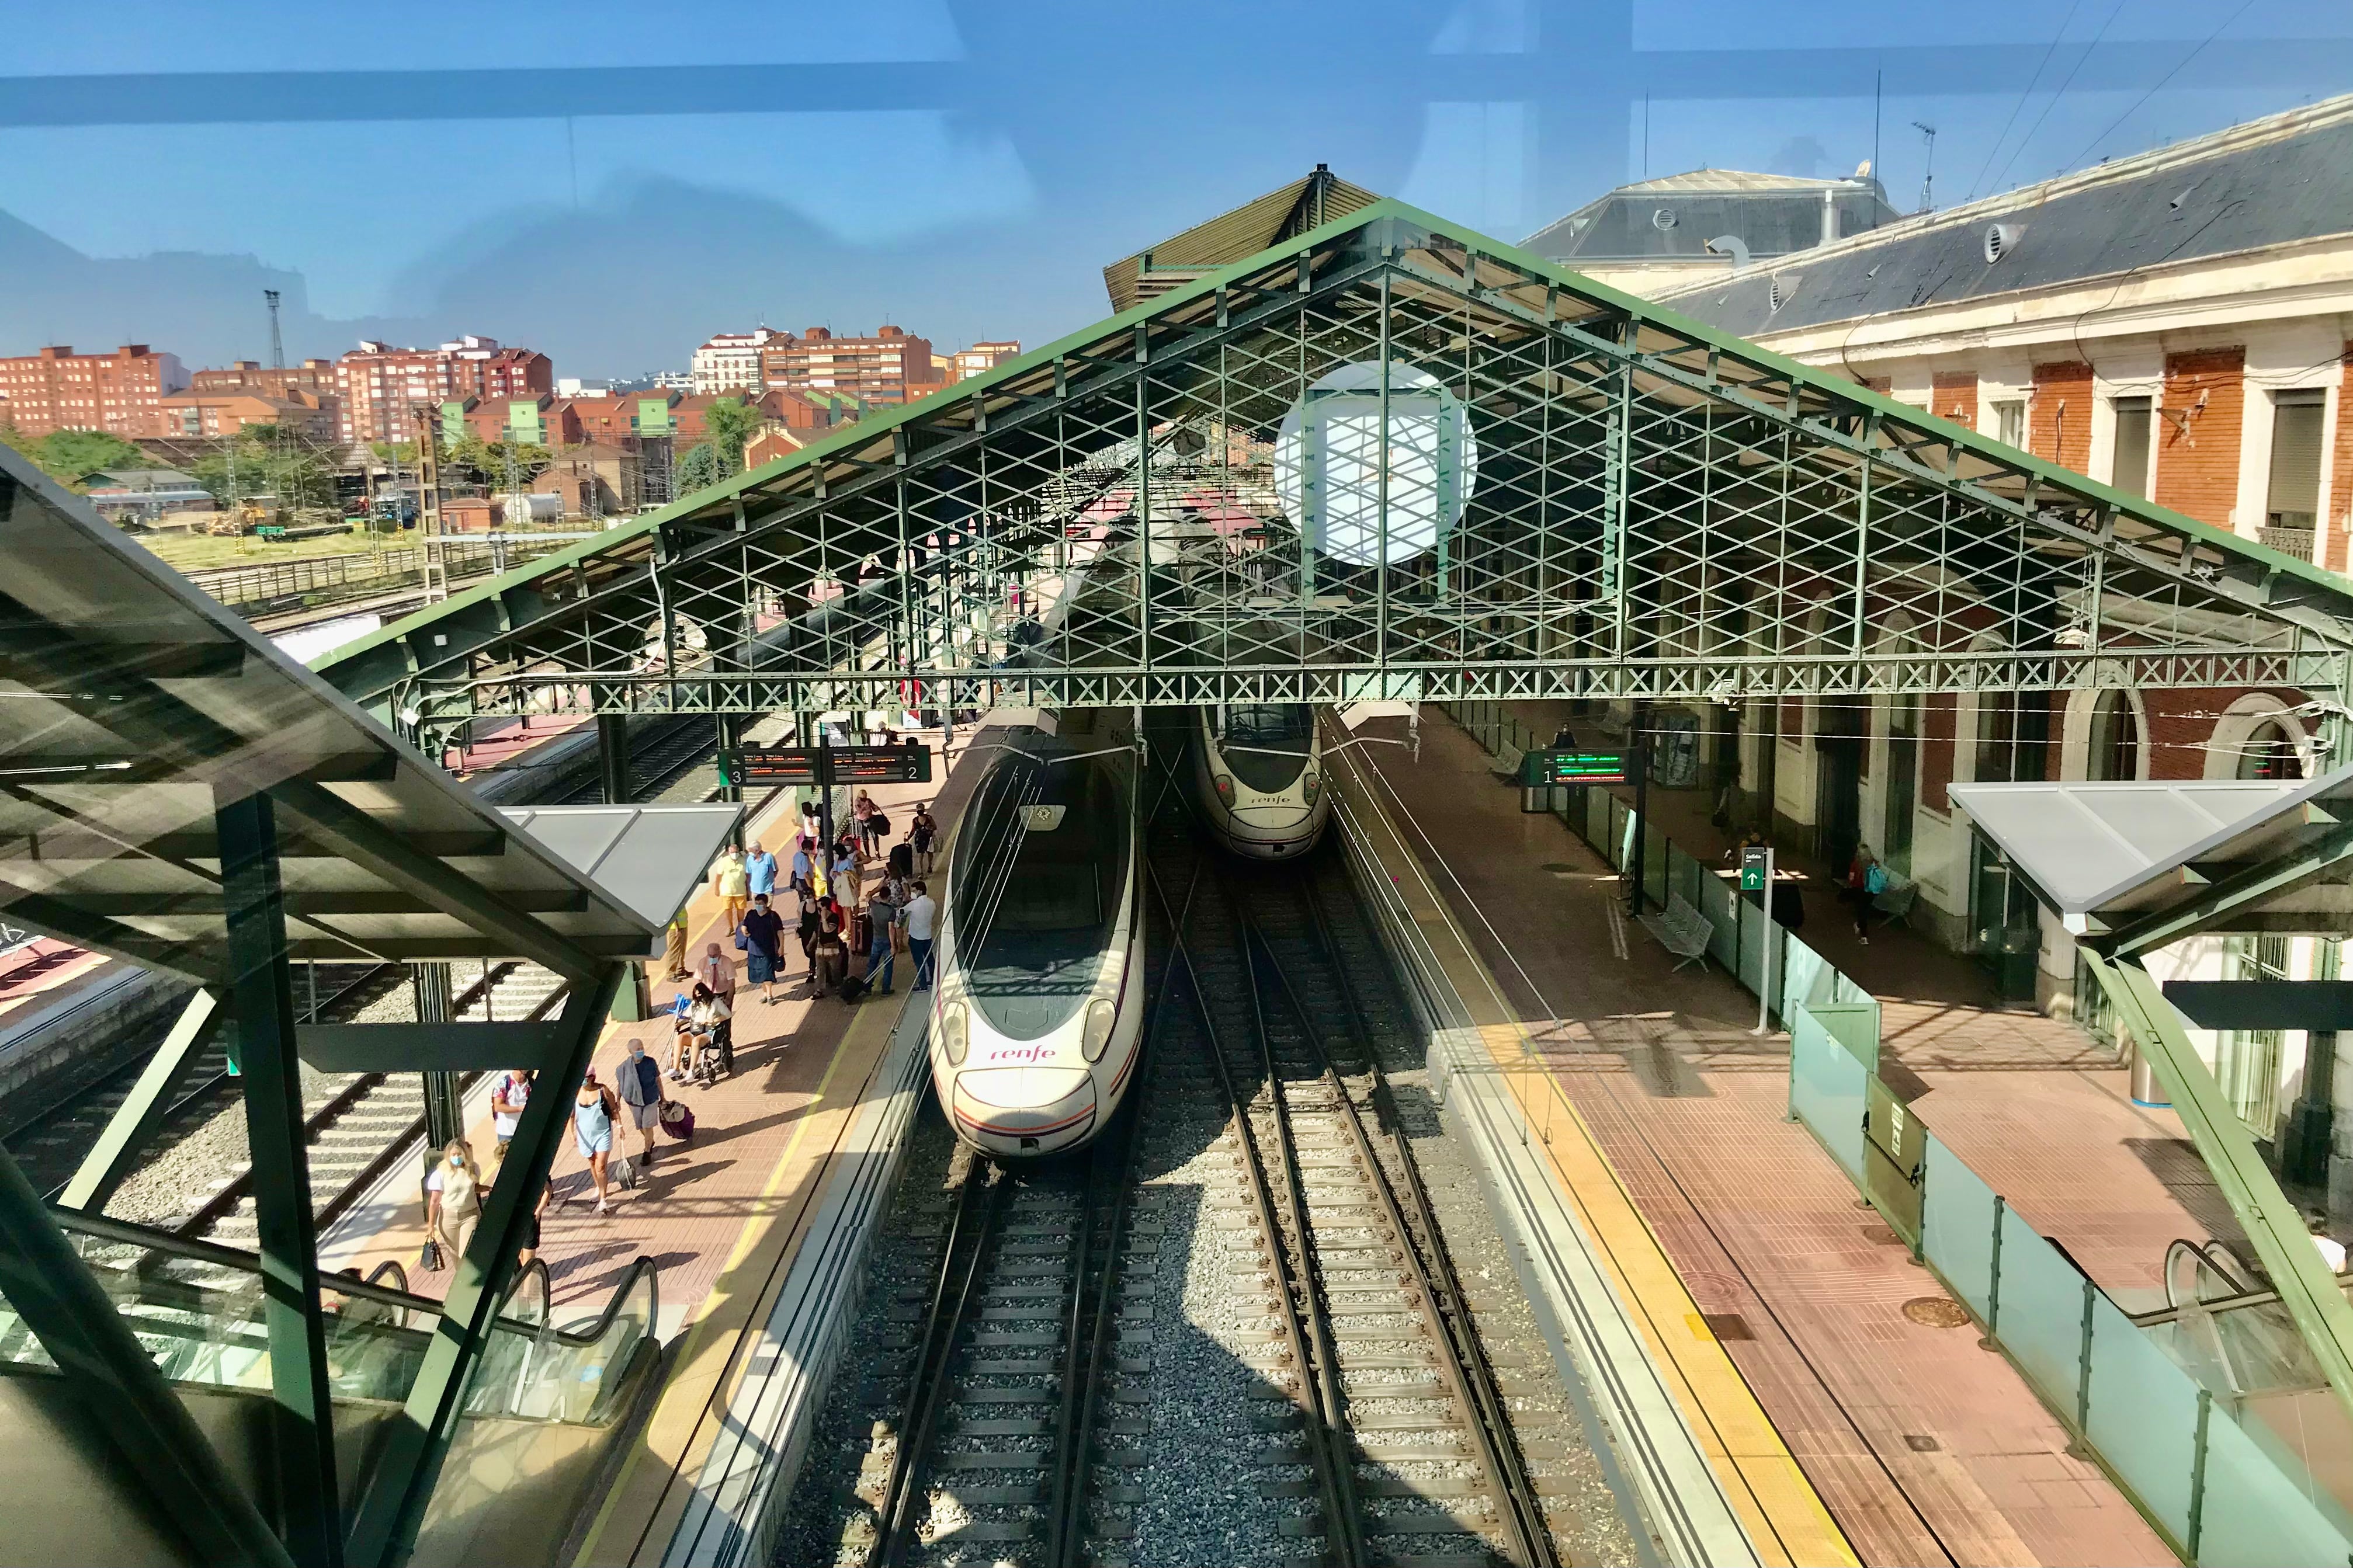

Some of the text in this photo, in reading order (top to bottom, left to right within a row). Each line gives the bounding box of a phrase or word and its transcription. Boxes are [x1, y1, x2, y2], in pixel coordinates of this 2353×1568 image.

[733, 771, 741, 783] 3
[908, 767, 917, 779] 2
[1545, 770, 1552, 783] 1
[991, 1045, 1056, 1063] renfe
